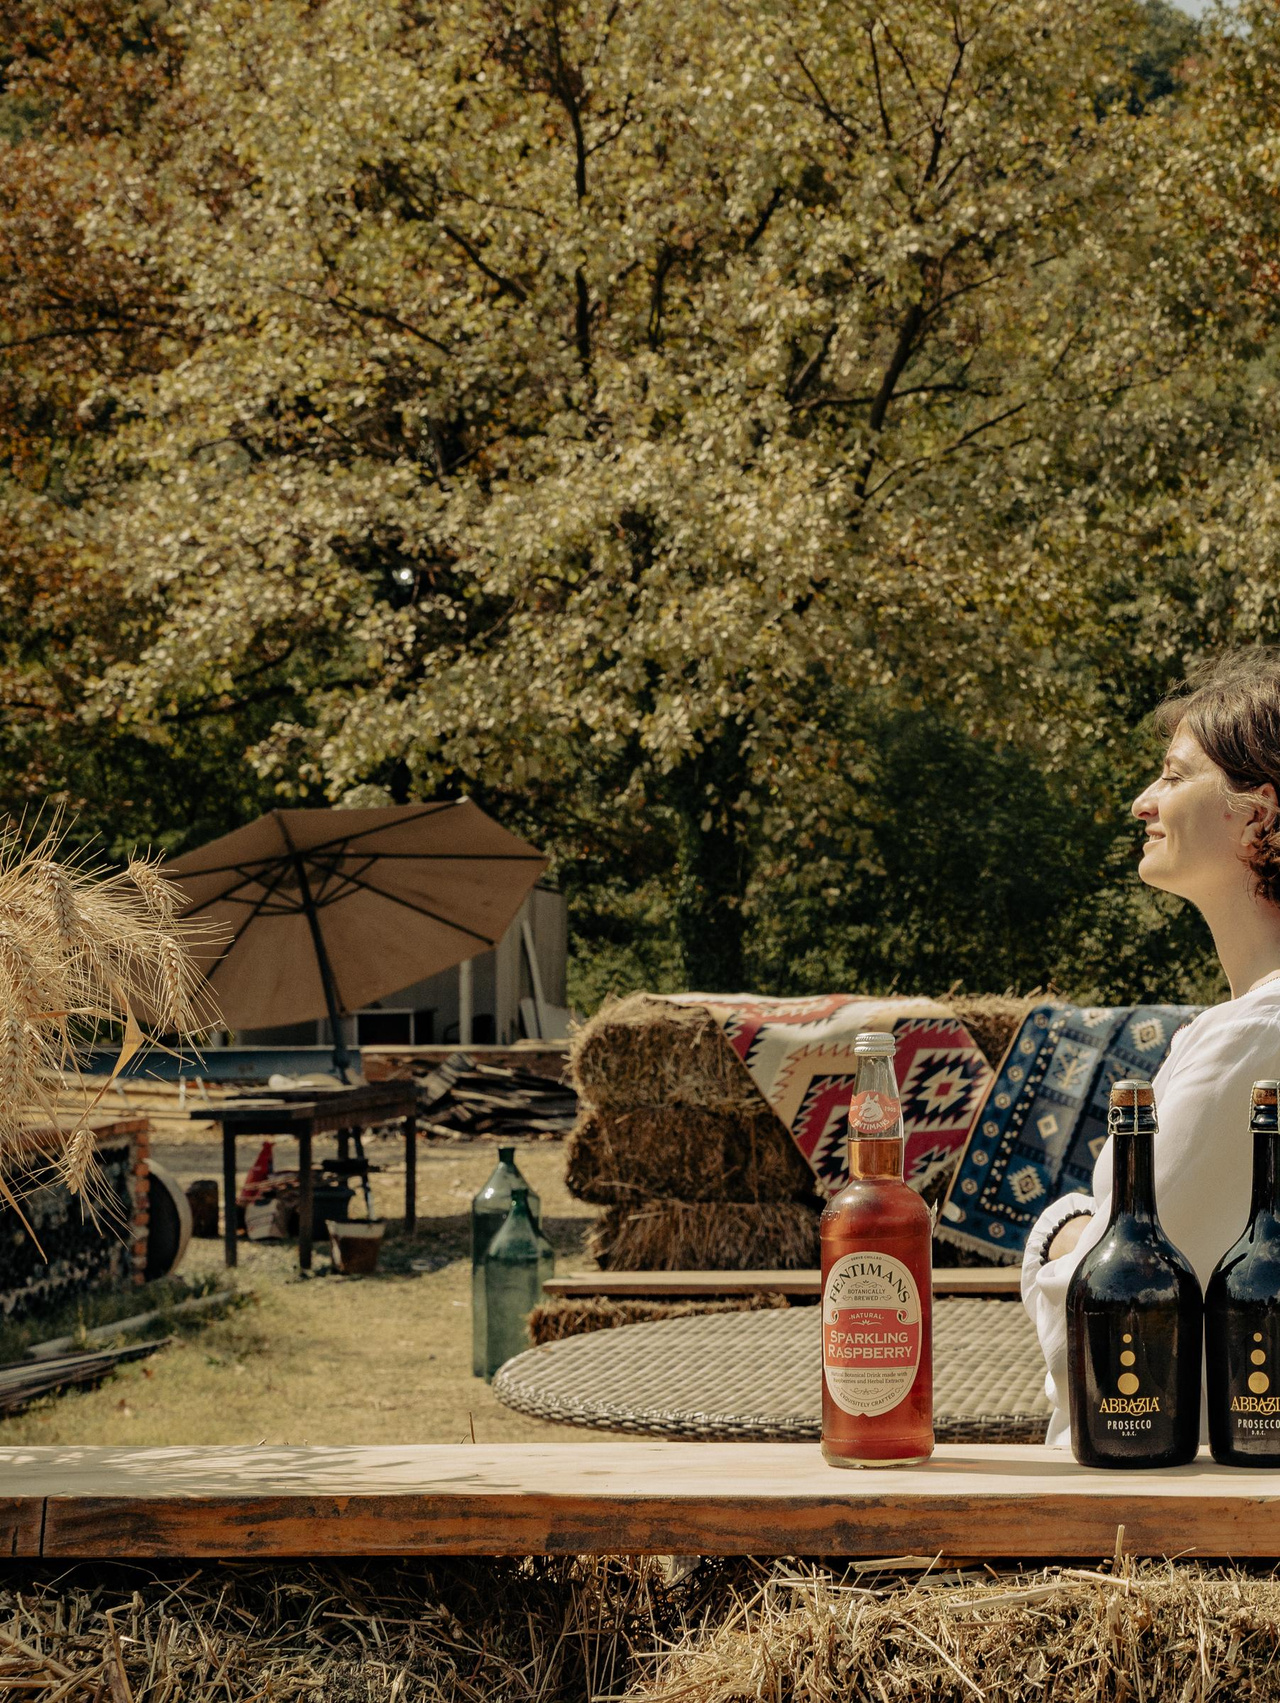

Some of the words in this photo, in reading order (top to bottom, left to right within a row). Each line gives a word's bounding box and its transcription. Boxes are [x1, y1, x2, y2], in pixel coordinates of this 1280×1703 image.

[829, 1263, 911, 1303] FENTIMANS
[830, 1330, 908, 1344] SPARKLING
[828, 1344, 912, 1359] RASPBERRY
[840, 1392, 870, 1408] EXQUISITELY
[871, 1392, 896, 1407] CRAFTED
[1099, 1396, 1160, 1416] ABBAZIA
[1107, 1420, 1152, 1430] PROSECCO
[1237, 1419, 1280, 1429] PROSECCO
